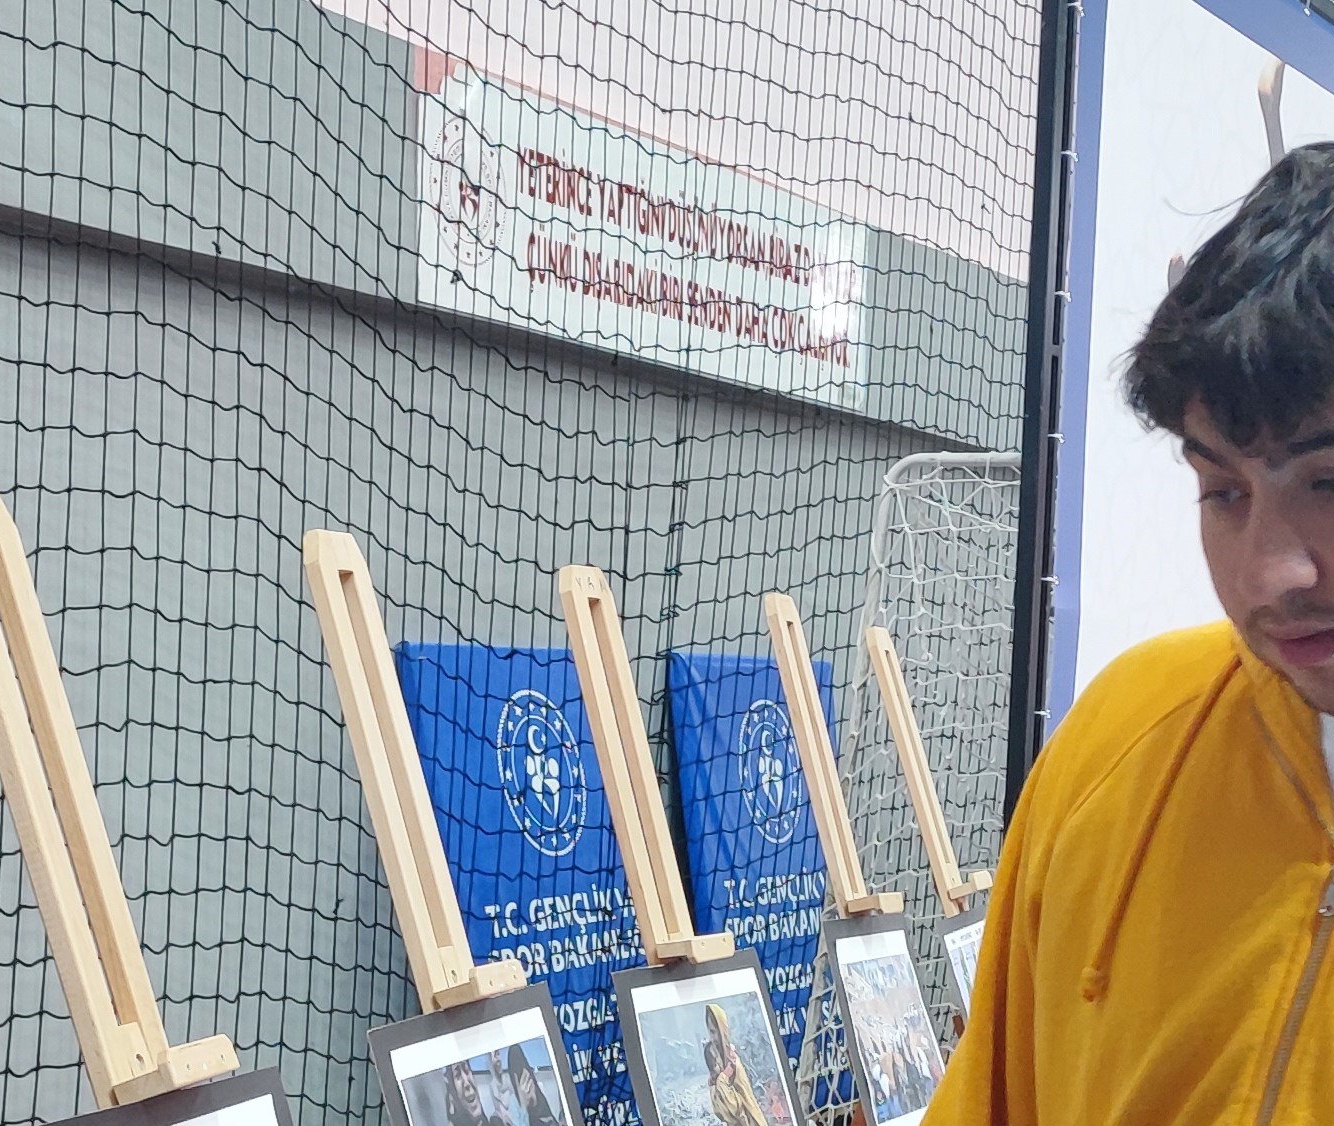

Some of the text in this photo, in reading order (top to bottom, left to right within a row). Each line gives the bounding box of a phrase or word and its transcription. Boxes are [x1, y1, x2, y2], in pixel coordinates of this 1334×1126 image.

[527, 224, 578, 293] ÇÜNKÜ
[484, 902, 528, 938] T.C.
[529, 883, 616, 933] GENÇLİK
[764, 963, 814, 993] YOZGA
